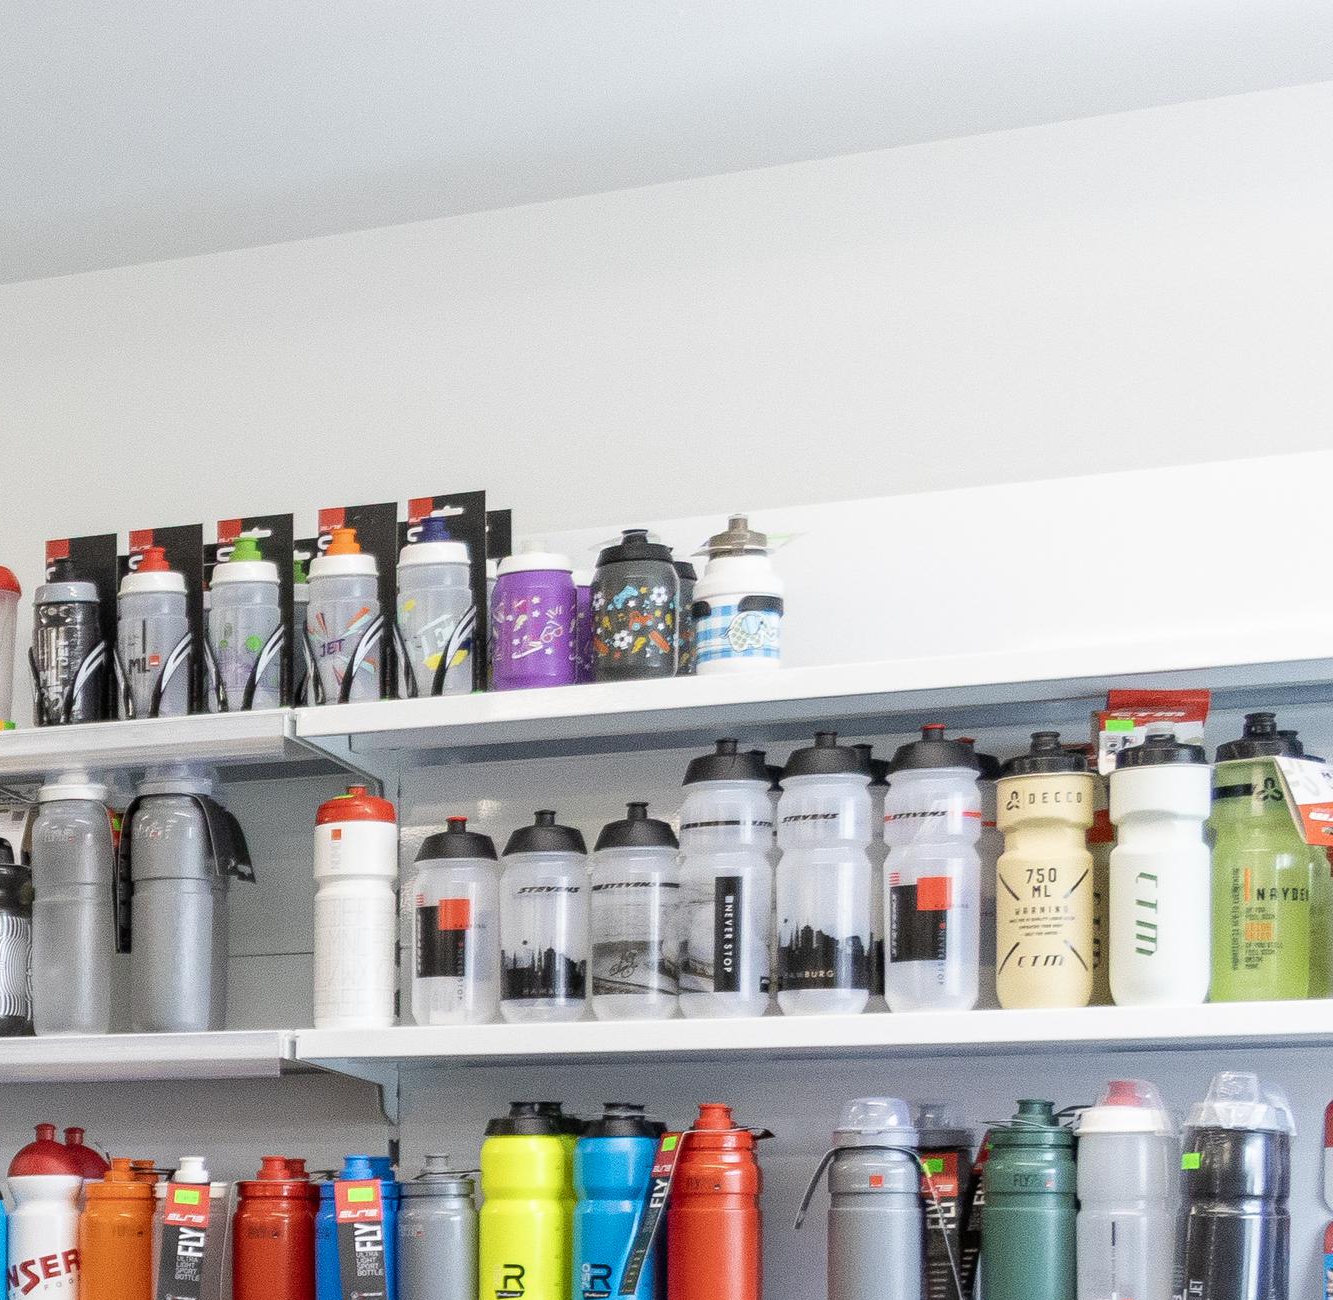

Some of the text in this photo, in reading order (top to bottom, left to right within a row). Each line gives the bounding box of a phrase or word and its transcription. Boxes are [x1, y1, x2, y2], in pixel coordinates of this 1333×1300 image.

[319, 638, 344, 658] JET
[1028, 791, 1083, 805] DECCO
[782, 813, 840, 824] STEVENS
[891, 810, 948, 821] STEVENS
[1025, 868, 1058, 884] 750
[518, 886, 580, 894] STEVENS
[1032, 885, 1052, 898] ML
[723, 904, 733, 974] NEVER STOP
[649, 1178, 669, 1208] FLY
[178, 1227, 206, 1258] FLY
[354, 1223, 382, 1254] FLY
[175, 1274, 200, 1282] BOTTLE
